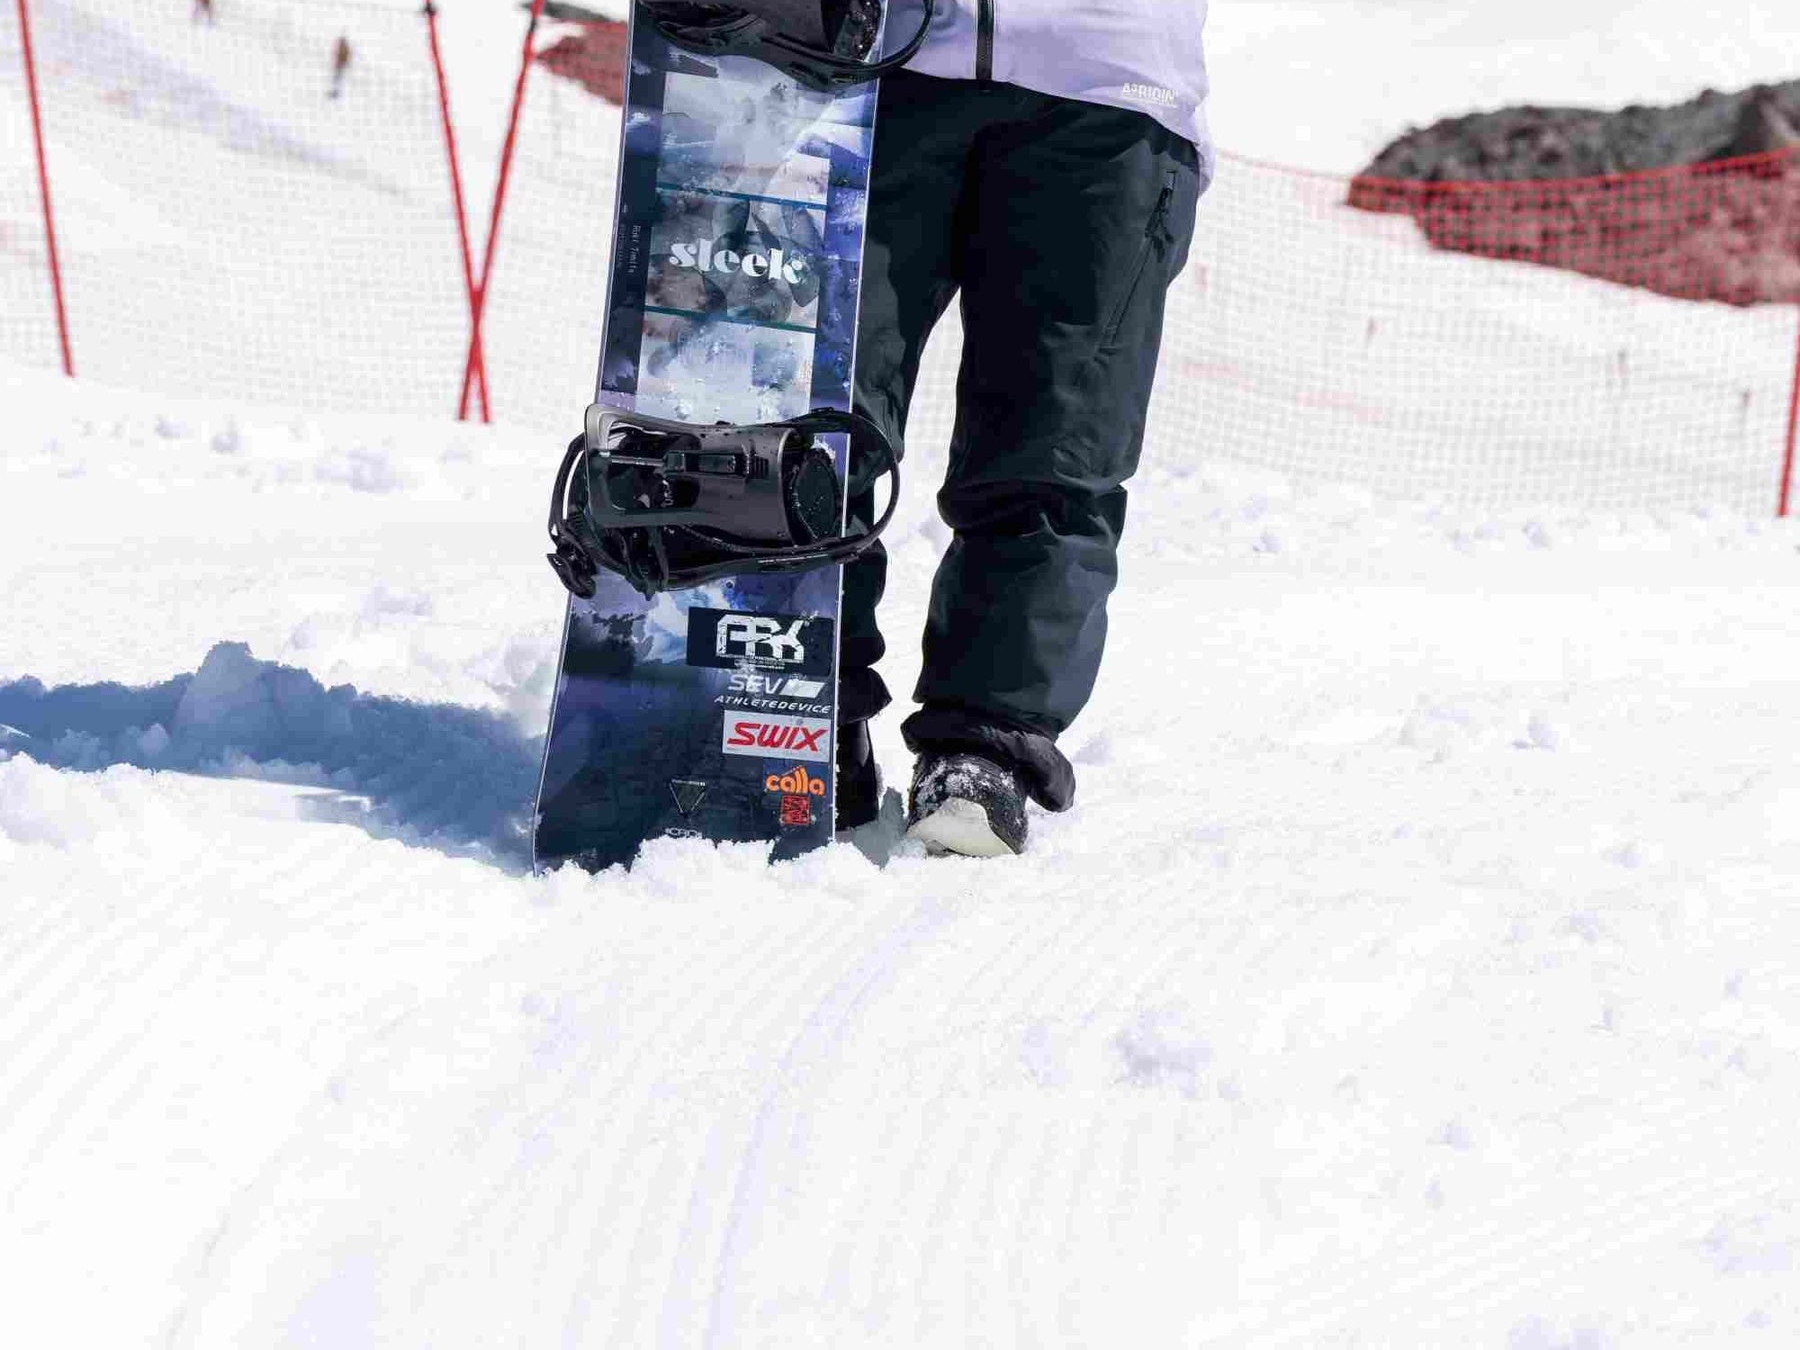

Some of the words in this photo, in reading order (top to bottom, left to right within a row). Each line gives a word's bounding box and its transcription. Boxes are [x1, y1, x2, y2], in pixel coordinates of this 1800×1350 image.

[669, 238, 807, 285] sleek
[728, 674, 783, 695] SEV
[714, 694, 831, 714] ATHLETEDEVICE
[727, 721, 829, 752] SWIX
[765, 765, 826, 797] calla
